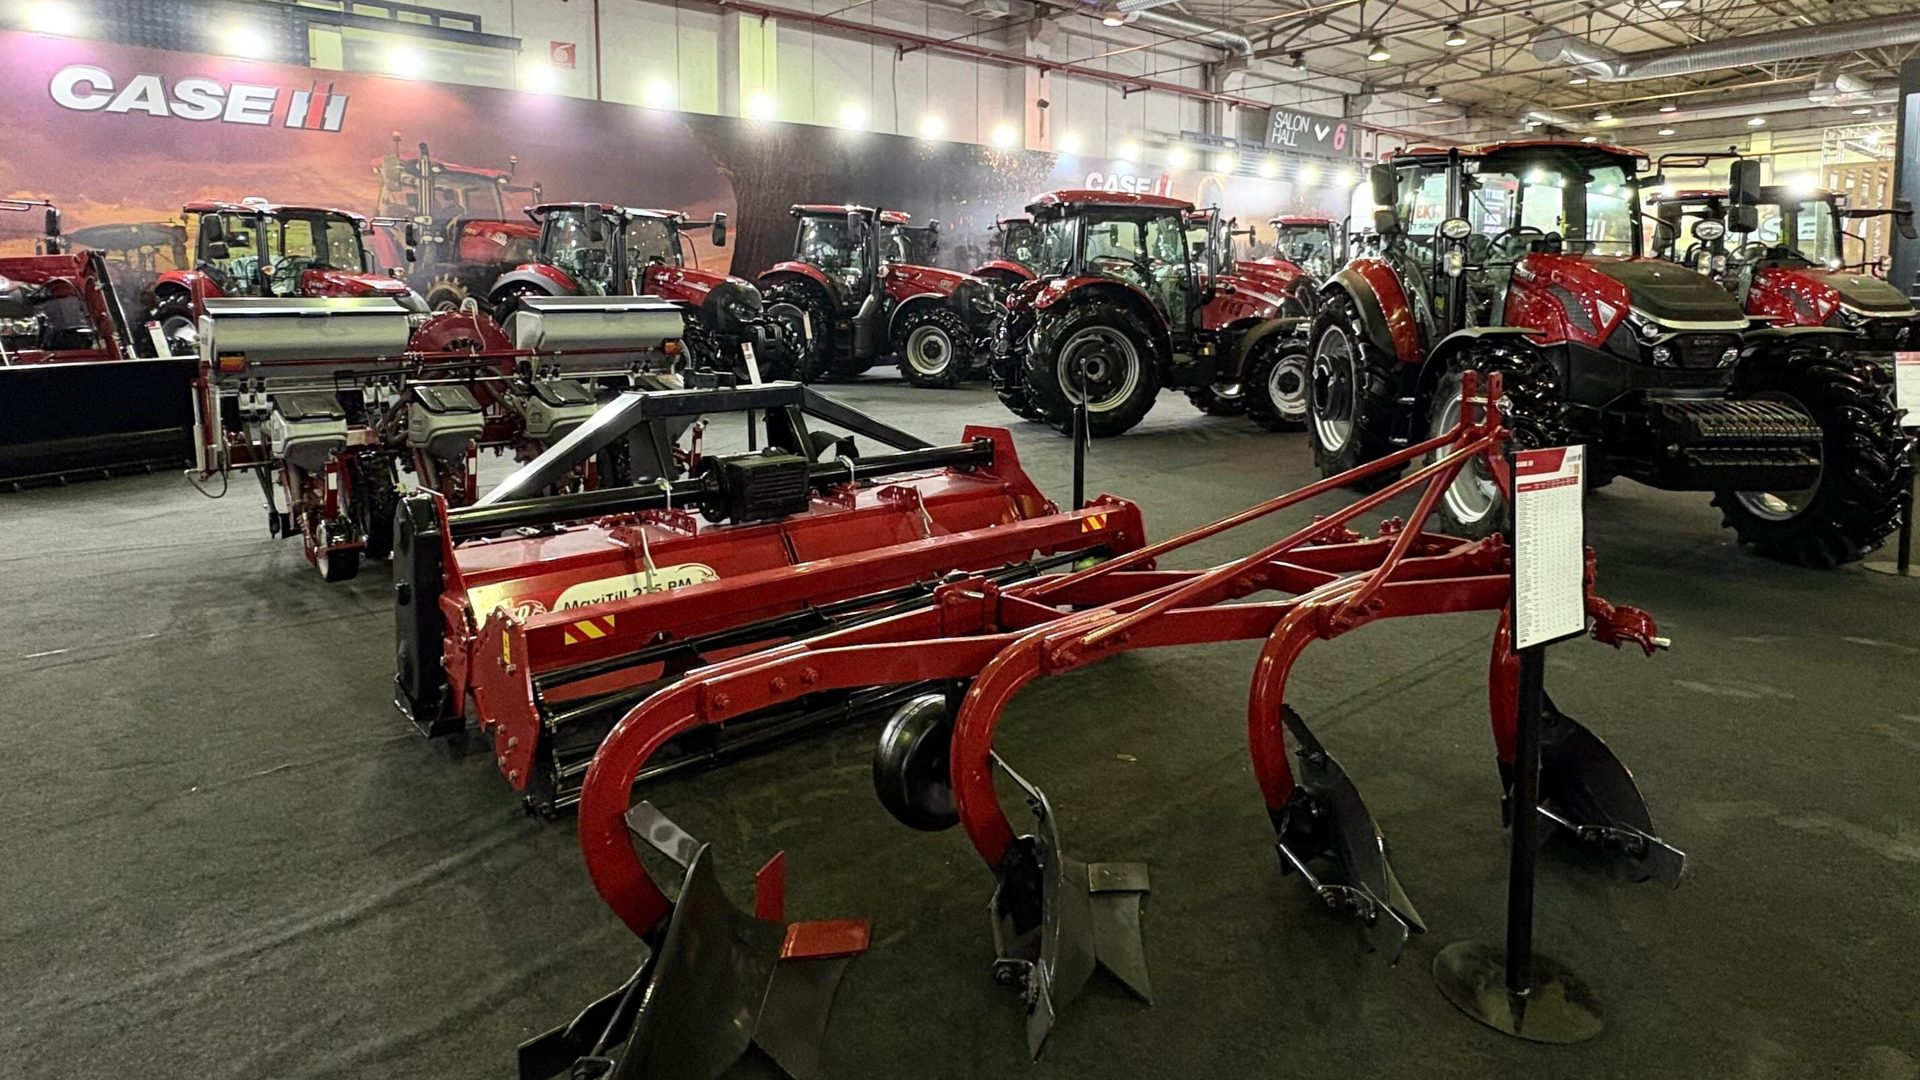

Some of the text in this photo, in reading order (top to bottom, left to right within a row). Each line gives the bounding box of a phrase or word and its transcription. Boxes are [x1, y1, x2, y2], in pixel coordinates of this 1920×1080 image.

[49, 65, 280, 126] CASE
[1274, 111, 1310, 133] SALON
[1271, 127, 1297, 147] HALL
[1333, 122, 1347, 150] 6
[1085, 172, 1151, 194] CASE
